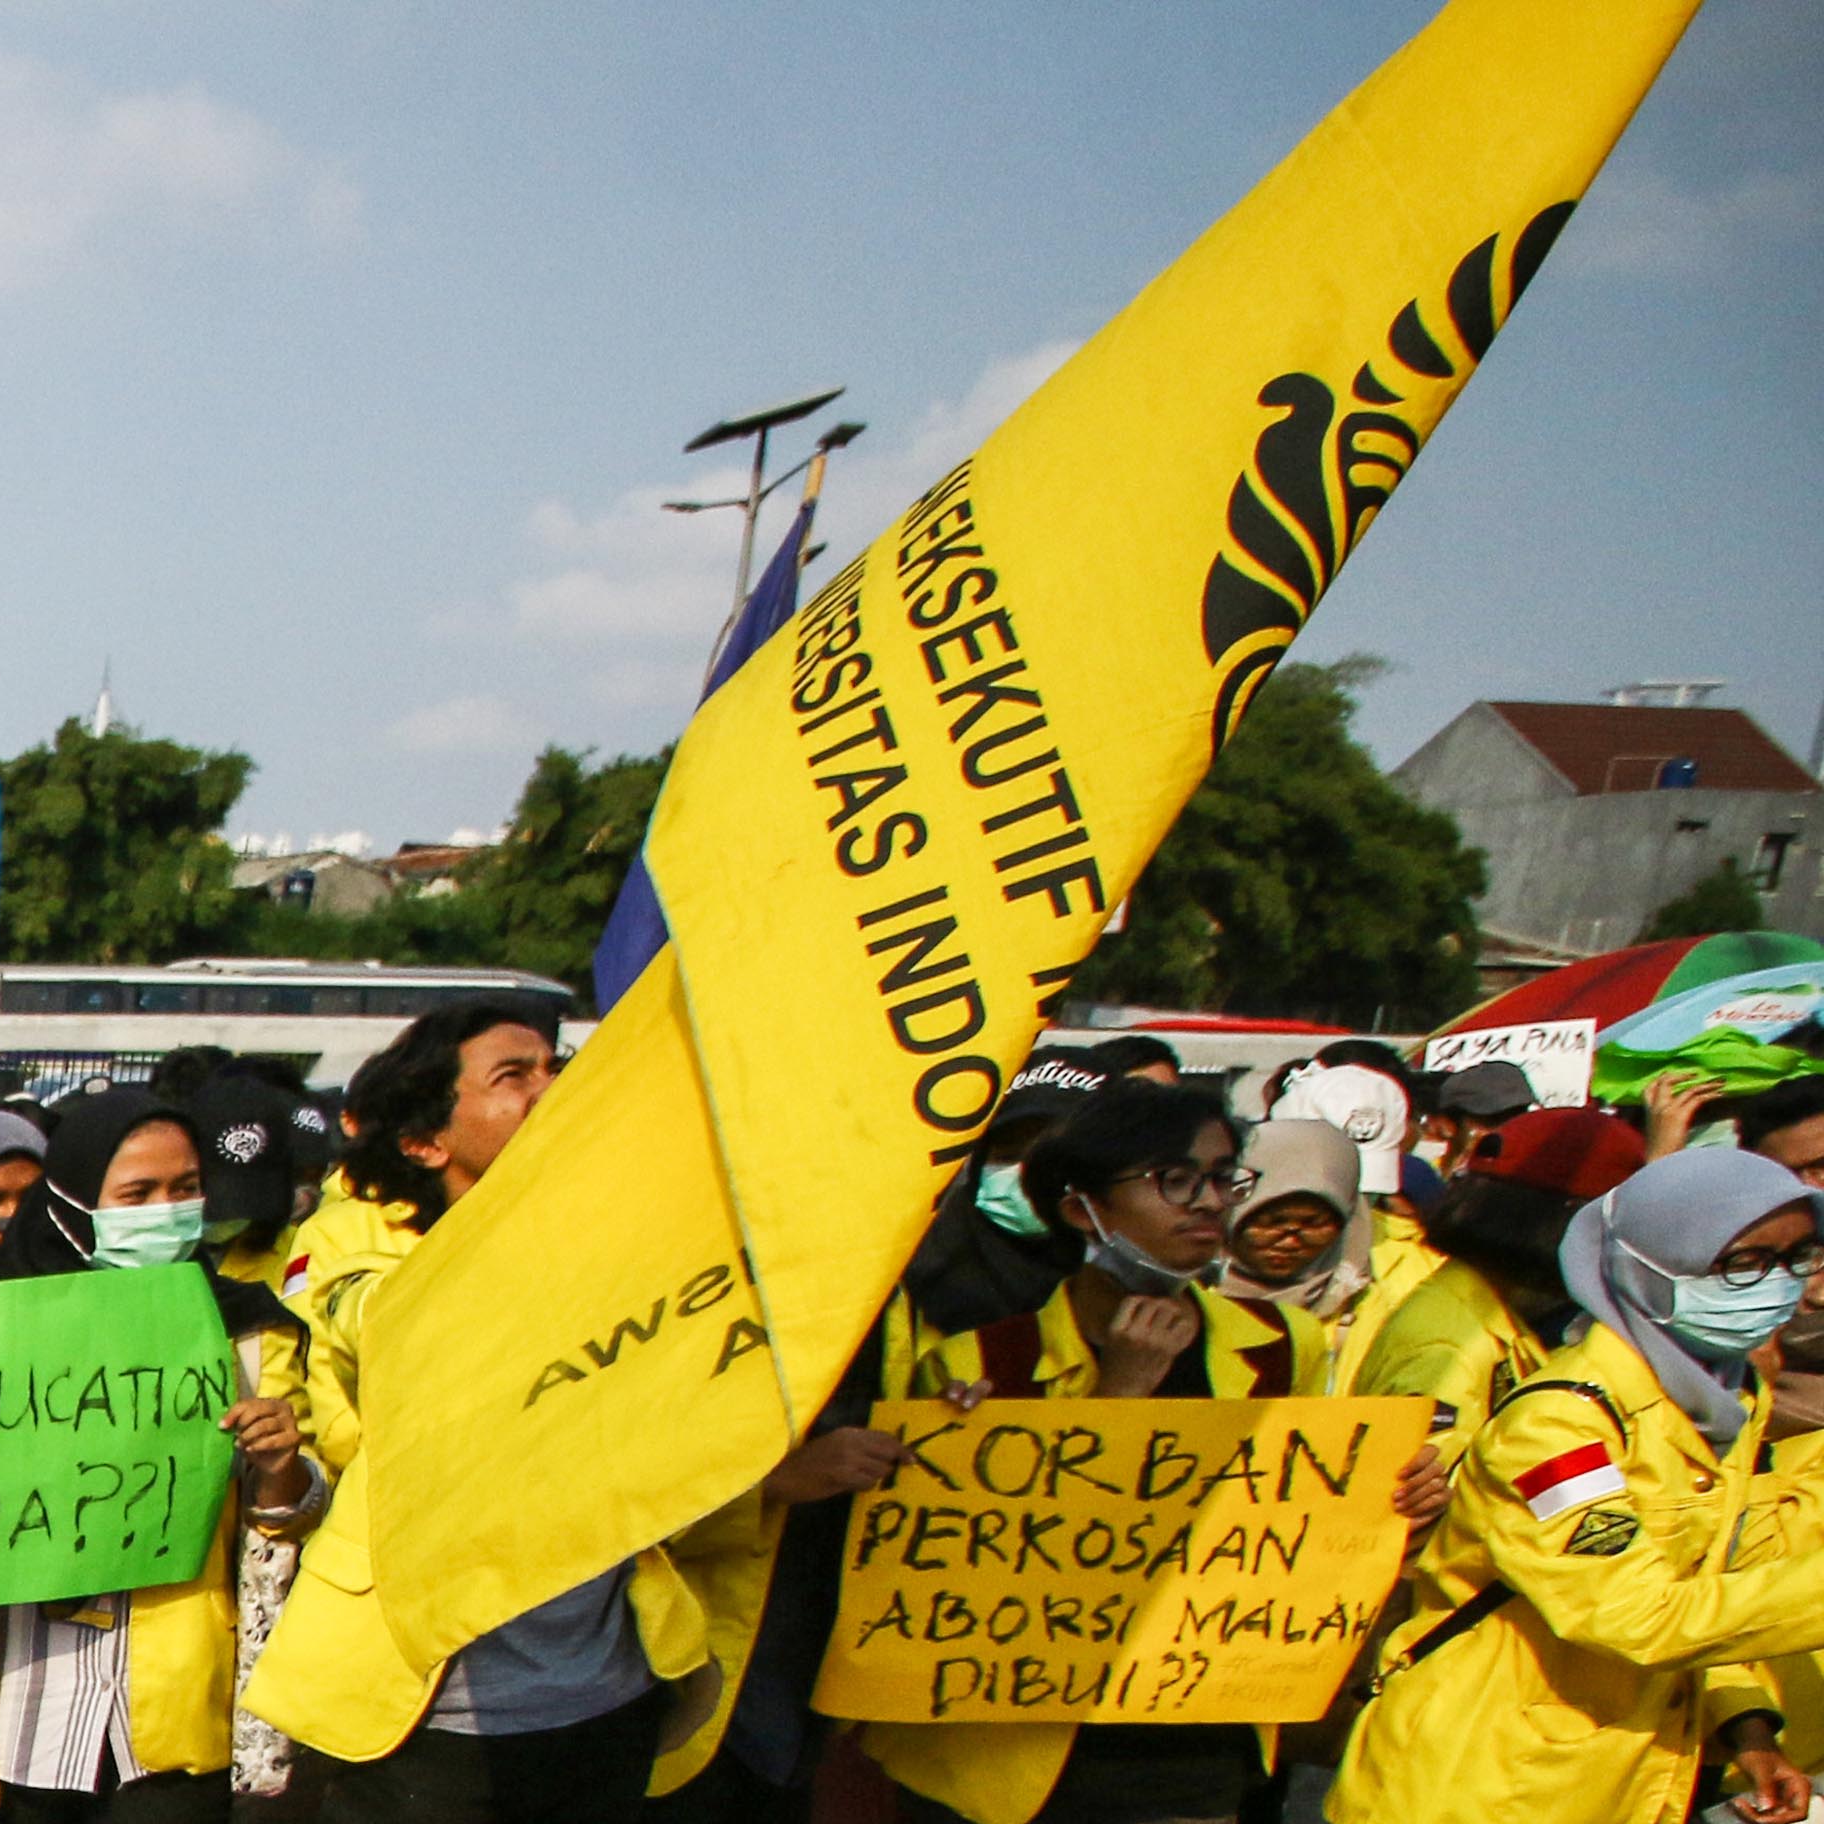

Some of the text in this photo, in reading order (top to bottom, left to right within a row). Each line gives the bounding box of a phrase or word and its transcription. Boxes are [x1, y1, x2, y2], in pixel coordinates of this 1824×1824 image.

[897, 498, 1106, 919] EKSEKUTIF
[879, 1421, 1370, 1504] KORBAN
[852, 1500, 1310, 1580] PERKOSAAN
[856, 1590, 1138, 1650] ABORSI
